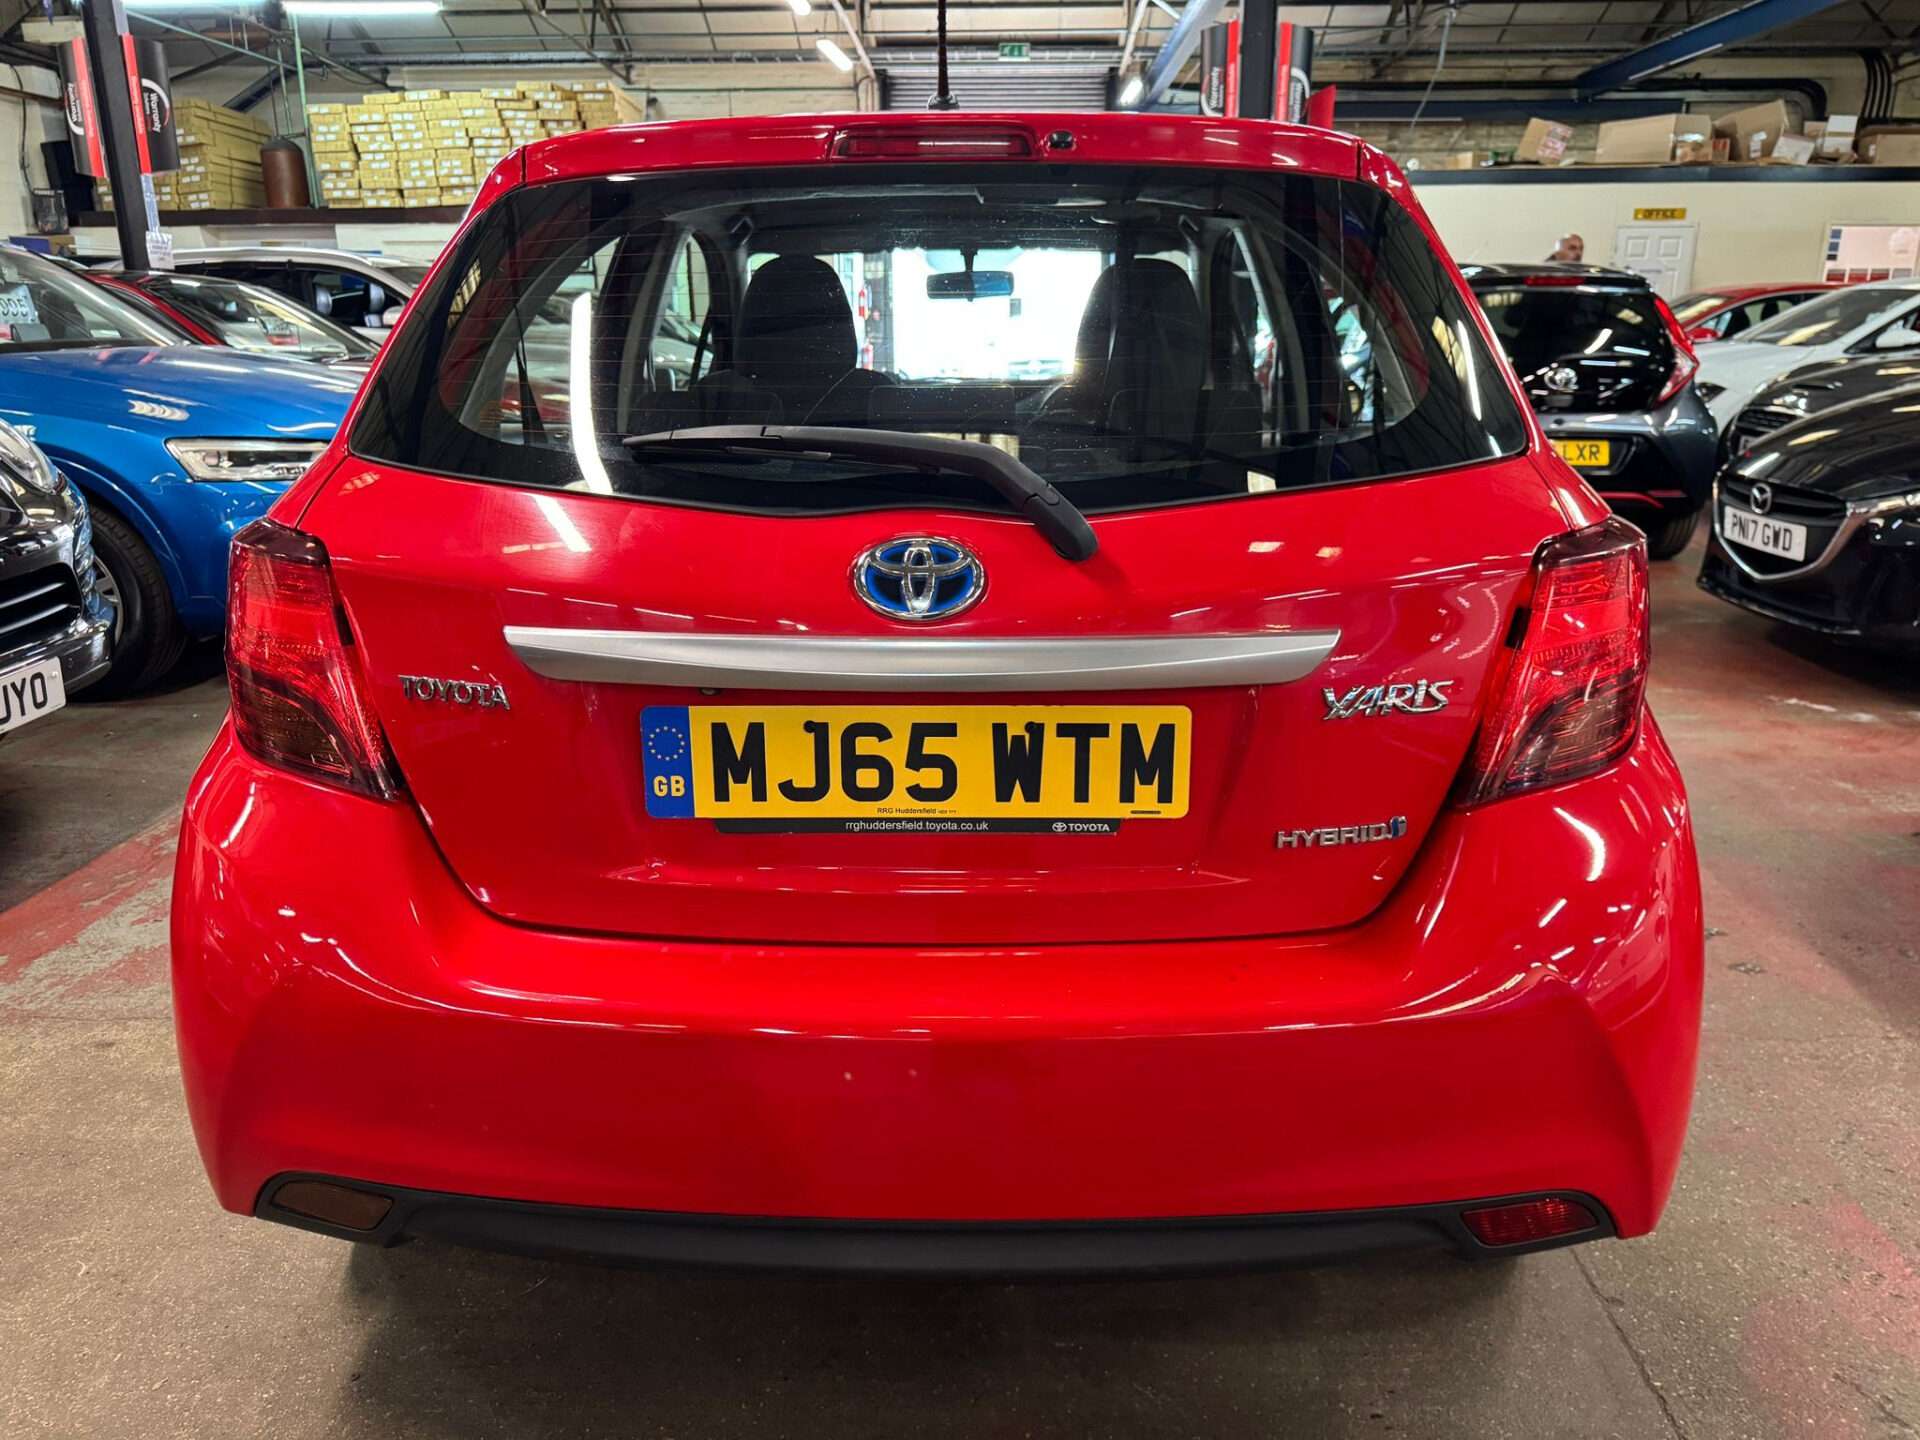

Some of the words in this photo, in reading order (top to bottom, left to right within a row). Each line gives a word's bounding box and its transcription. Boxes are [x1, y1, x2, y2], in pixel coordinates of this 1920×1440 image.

[150, 92, 162, 133] Warranty
[1731, 513, 1759, 542] PN17
[1762, 523, 1792, 552] GWD
[398, 674, 510, 711] TOYOTA
[1323, 679, 1454, 720] YARIS
[711, 722, 958, 803] MJ65
[992, 722, 1177, 804] WTM
[653, 775, 685, 797] GB
[845, 820, 989, 832] rrghuddersfield.toyota.co.uk
[1068, 823, 1110, 832] TOYOTA
[1277, 822, 1391, 849] HYBRID
